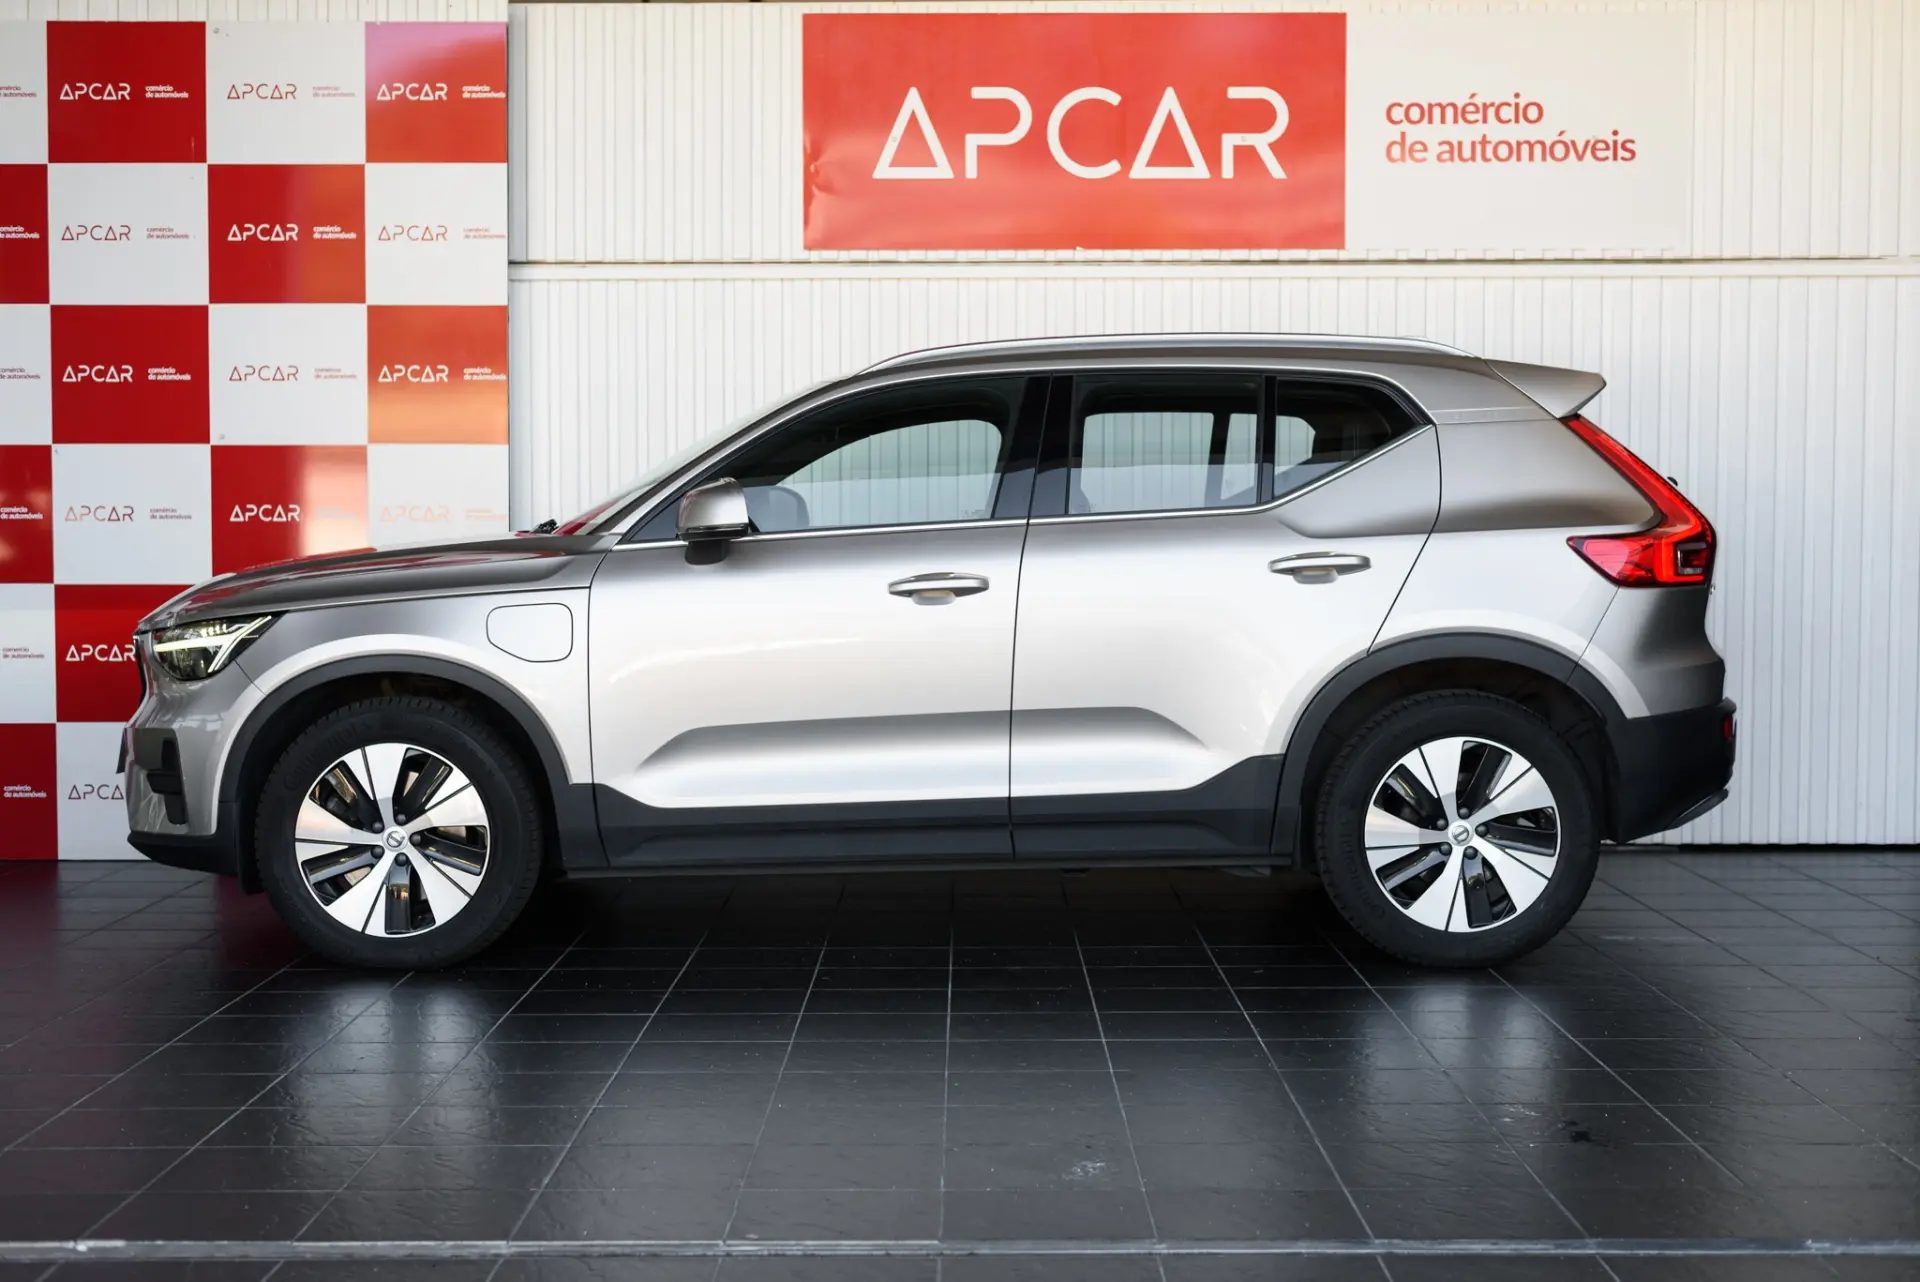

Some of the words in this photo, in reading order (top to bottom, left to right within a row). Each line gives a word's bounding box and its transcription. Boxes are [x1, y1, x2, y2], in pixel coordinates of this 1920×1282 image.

[60, 83, 130, 100] APCAR
[227, 84, 297, 100] APCAR
[377, 83, 448, 100] APCAR
[1386, 92, 1544, 126] comércio
[872, 87, 1289, 180] APCAR
[1386, 131, 1428, 163] de
[1435, 130, 1636, 163] automóveis
[61, 225, 131, 241] APCAR
[227, 224, 298, 241] APCAR
[378, 225, 448, 241] APCAR
[63, 365, 133, 382] APCAR
[229, 365, 298, 382] APCAR
[378, 365, 449, 382] APCAR
[65, 505, 134, 522] APCAR
[230, 504, 301, 522] APCAR
[66, 644, 135, 662] APCAR
[68, 784, 124, 800] APCA
